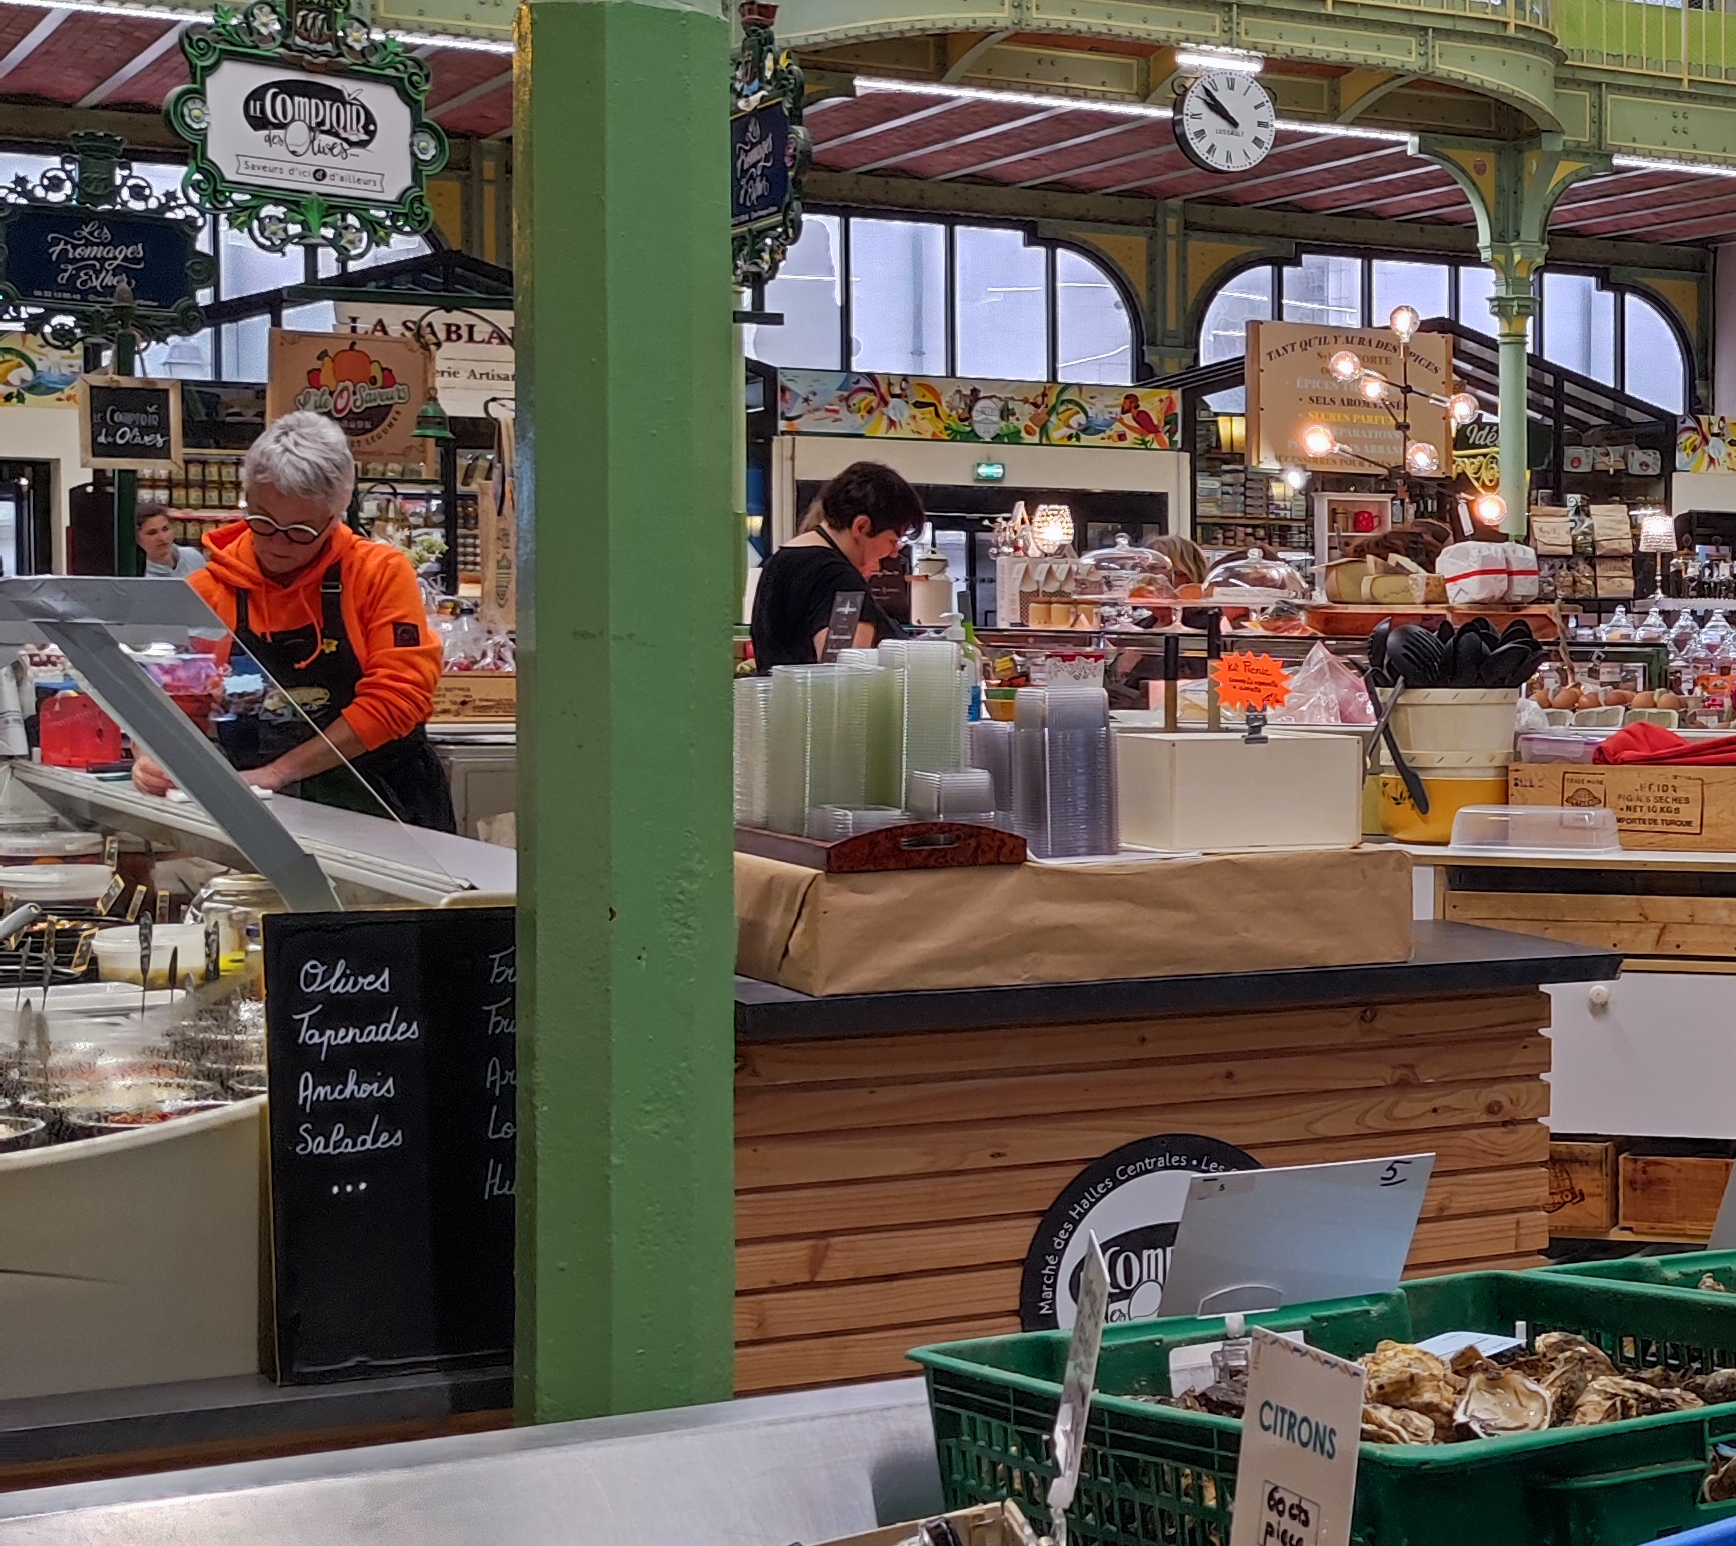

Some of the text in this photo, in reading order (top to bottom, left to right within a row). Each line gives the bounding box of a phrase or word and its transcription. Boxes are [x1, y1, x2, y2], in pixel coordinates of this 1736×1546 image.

[250, 100, 263, 117] LE
[264, 120, 349, 160] des Olives
[244, 160, 377, 187] Saveurs d'ici d'ailleurs
[74, 220, 111, 244] Les
[47, 233, 145, 269] Fromages
[348, 316, 391, 337] LA
[1266, 341, 1297, 362] TANT
[1299, 335, 1330, 352] QU'IL
[1332, 335, 1341, 345] Y
[1344, 335, 1373, 348] AURA
[1376, 339, 1399, 354] DES
[1405, 349, 1441, 375] PICES
[435, 368, 460, 379] erie
[1308, 395, 1336, 406] SELS
[1308, 410, 1350, 423] SUCRES
[1626, 805, 1680, 814] NET 10 KGS
[1653, 795, 1690, 805] SECHES
[1616, 817, 1647, 826] MPORTE
[1661, 819, 1694, 828] TURQUIE
[300, 959, 390, 994] Olives
[292, 1004, 419, 1061] Tapenades
[298, 1068, 395, 1113] Anchois
[295, 1114, 403, 1154] Salades
[1381, 1160, 1413, 1181] 5
[1039, 1253, 1059, 1315] Marché
[1053, 1221, 1074, 1251] des
[1069, 1178, 1113, 1220] Halles
[1115, 1153, 1187, 1181] Centrales
[1259, 1400, 1338, 1460] CITRONS
